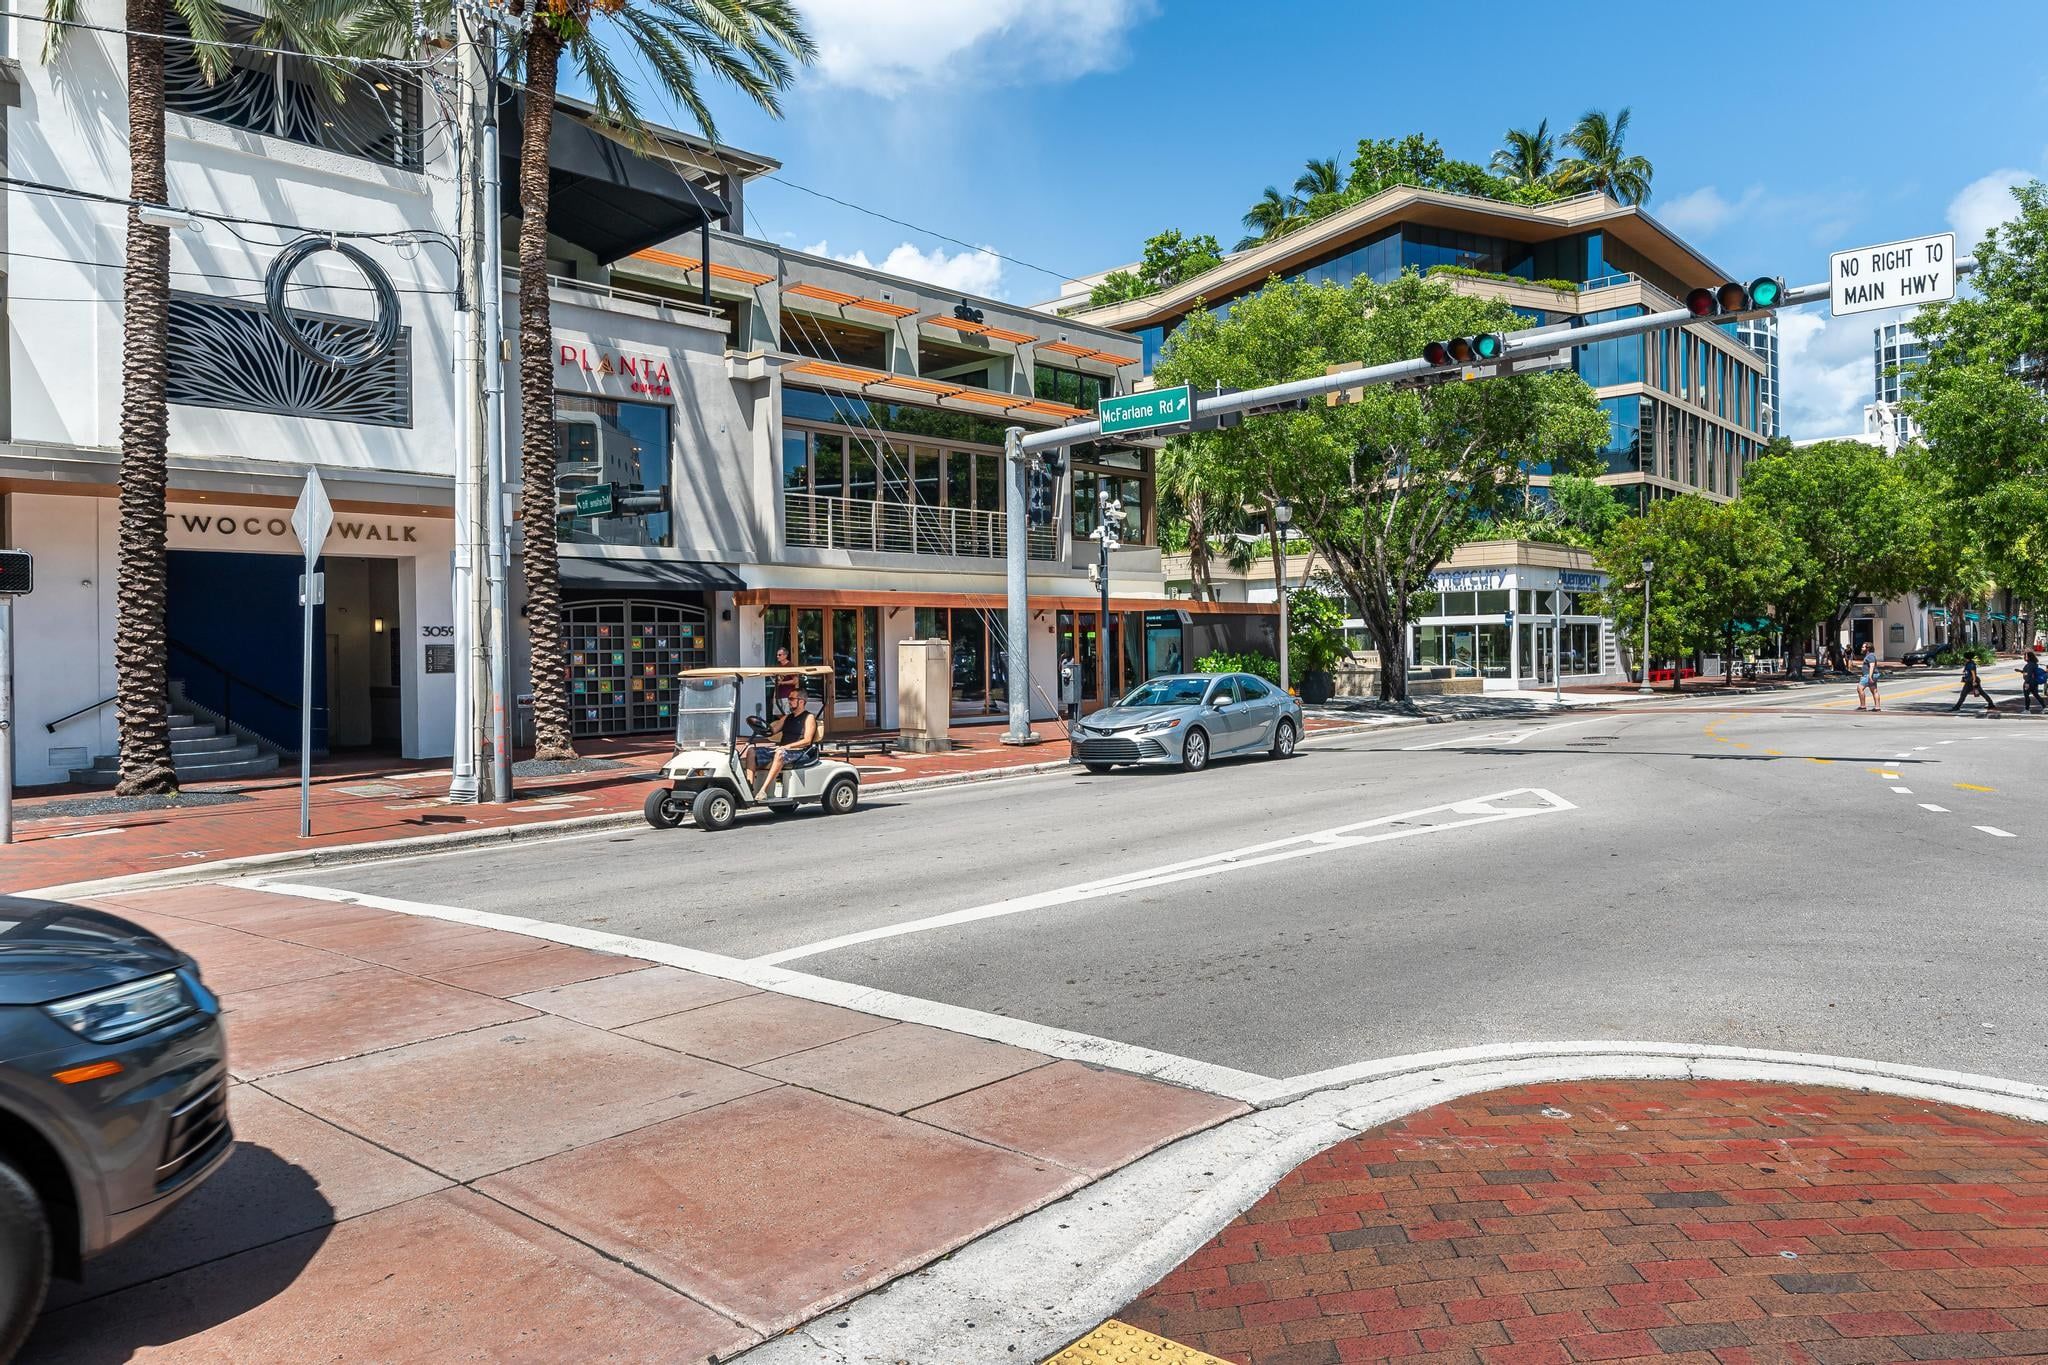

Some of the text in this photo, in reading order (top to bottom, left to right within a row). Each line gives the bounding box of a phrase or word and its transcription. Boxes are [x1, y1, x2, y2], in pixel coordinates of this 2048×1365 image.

[1841, 243, 1943, 278] NO RIGHT TO
[1845, 273, 1939, 305] MAIN HWY
[953, 298, 984, 324] sbe
[561, 345, 670, 382] PLANTA
[1102, 399, 1174, 424] McFarlane Rd
[422, 625, 454, 637] 3059
